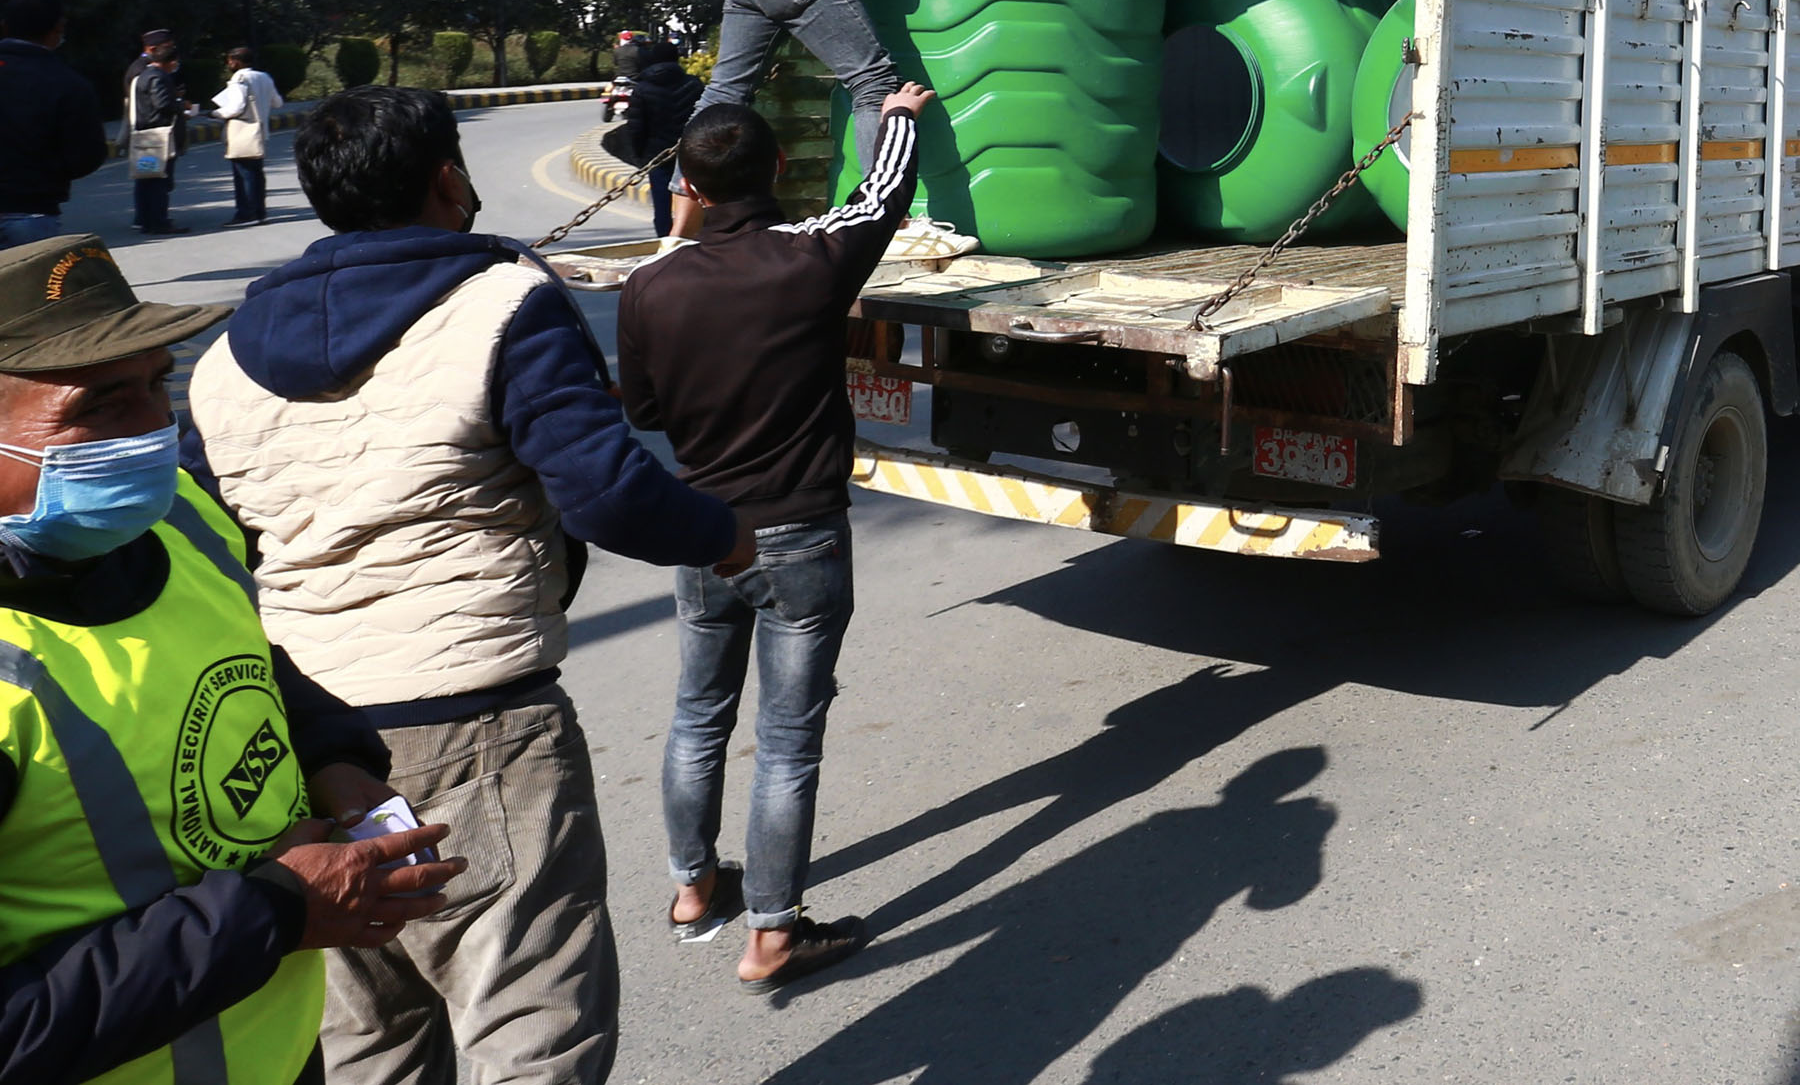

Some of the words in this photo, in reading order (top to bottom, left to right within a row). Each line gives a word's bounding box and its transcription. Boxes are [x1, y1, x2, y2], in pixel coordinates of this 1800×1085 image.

[46, 251, 83, 300] NATIONAL
[209, 663, 267, 691] SERVICE
[181, 684, 214, 774] SECURITY
[223, 726, 281, 812] NSS
[180, 780, 224, 862] NATIONAL
